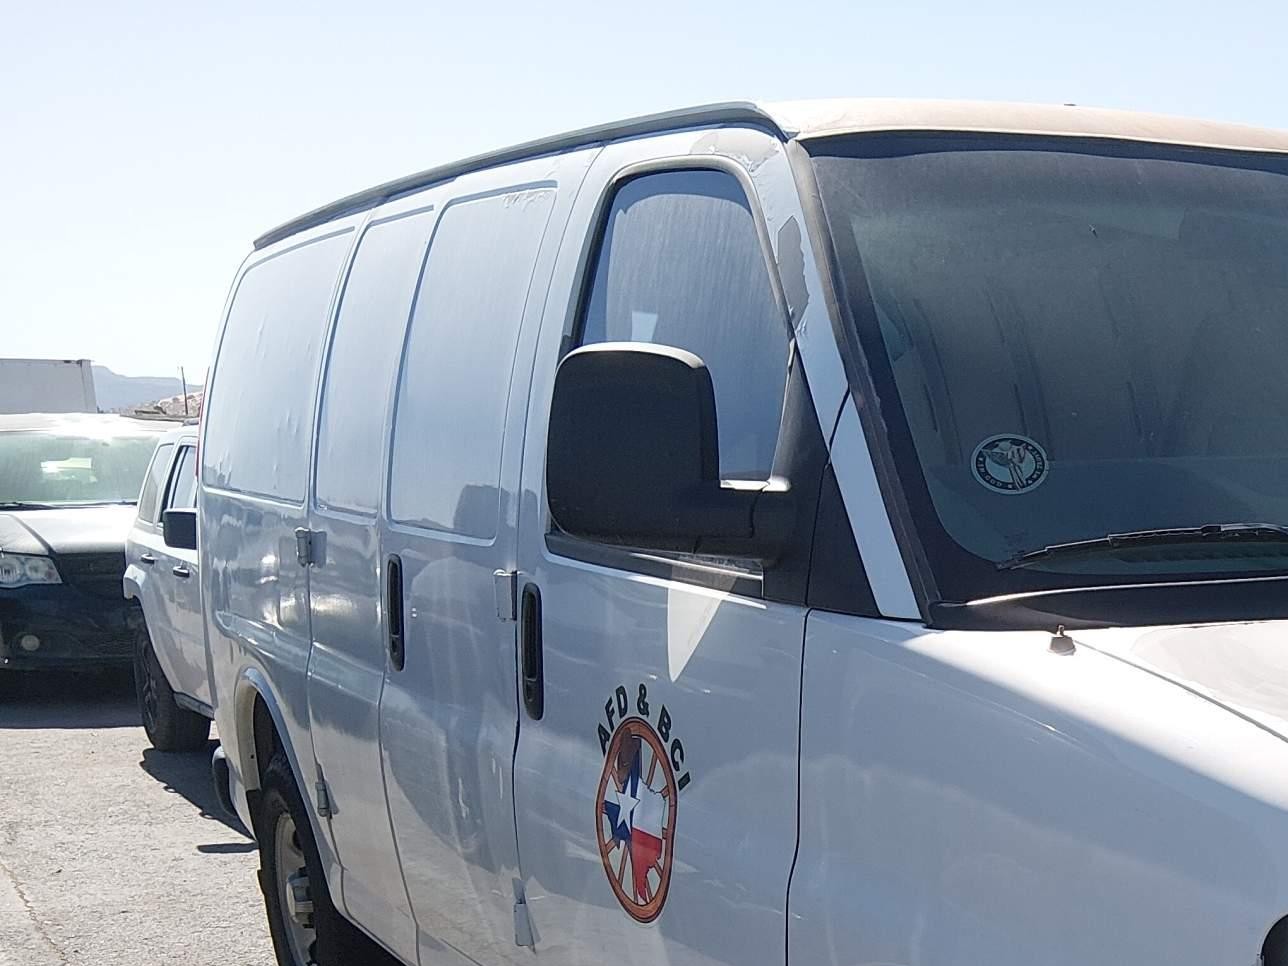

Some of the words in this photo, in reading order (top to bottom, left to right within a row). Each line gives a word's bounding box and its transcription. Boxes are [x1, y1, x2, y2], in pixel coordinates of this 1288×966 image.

[597, 685, 628, 758] AFD
[637, 683, 649, 718] &
[657, 704, 691, 791] BCI
